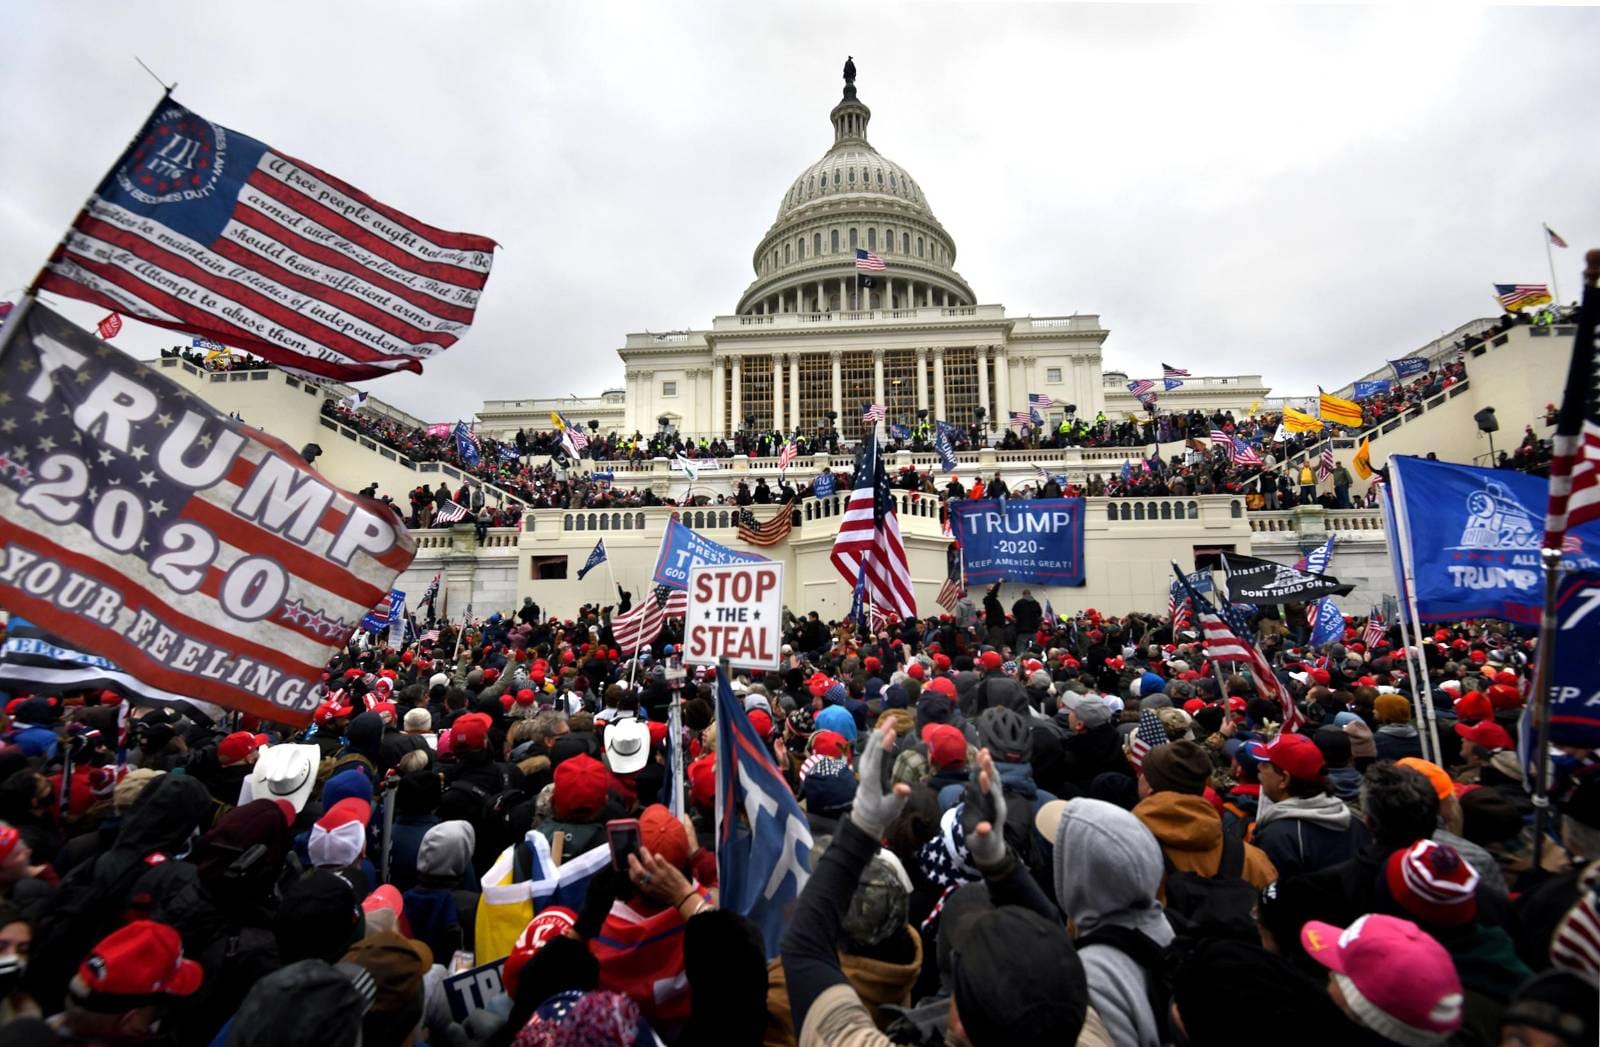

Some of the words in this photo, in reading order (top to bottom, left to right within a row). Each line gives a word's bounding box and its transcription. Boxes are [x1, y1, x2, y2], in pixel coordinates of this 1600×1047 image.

[147, 157, 184, 179] 1776
[184, 182, 216, 200] DUTY
[269, 158, 284, 175] A
[285, 169, 317, 192] free
[318, 189, 371, 223] people
[372, 219, 417, 249] ought
[417, 245, 442, 259] not
[247, 194, 303, 228] armed
[303, 225, 335, 243] and
[420, 280, 452, 297] But
[157, 231, 225, 274] maintain
[244, 269, 290, 301] status
[290, 295, 309, 312] of
[229, 228, 282, 261] should
[284, 250, 321, 278] have
[322, 271, 392, 308] sufficient
[392, 303, 432, 327] arms
[134, 260, 198, 300] Attempt
[199, 294, 218, 309] to
[221, 306, 265, 334] abuse
[267, 322, 312, 355] them,
[27, 333, 397, 565] TRUMP
[21, 454, 286, 621] 2020
[963, 511, 1070, 535] TRUMP
[665, 567, 686, 580] GOD
[968, 559, 992, 569] KEEP
[995, 557, 1036, 568] AMERICA
[1038, 560, 1073, 570] GREAT!
[1232, 563, 1273, 577] LIBERTY
[1512, 554, 1538, 566] ALL
[695, 570, 776, 604] STOP
[1241, 587, 1270, 599] DONT
[1271, 584, 1305, 597] TREAD
[1306, 579, 1323, 590] ON
[1448, 566, 1538, 590] TRUMP
[1, 546, 121, 625] YOUR
[129, 609, 323, 712] FEELINGS
[717, 607, 748, 623] THE
[690, 626, 773, 661] STEAL
